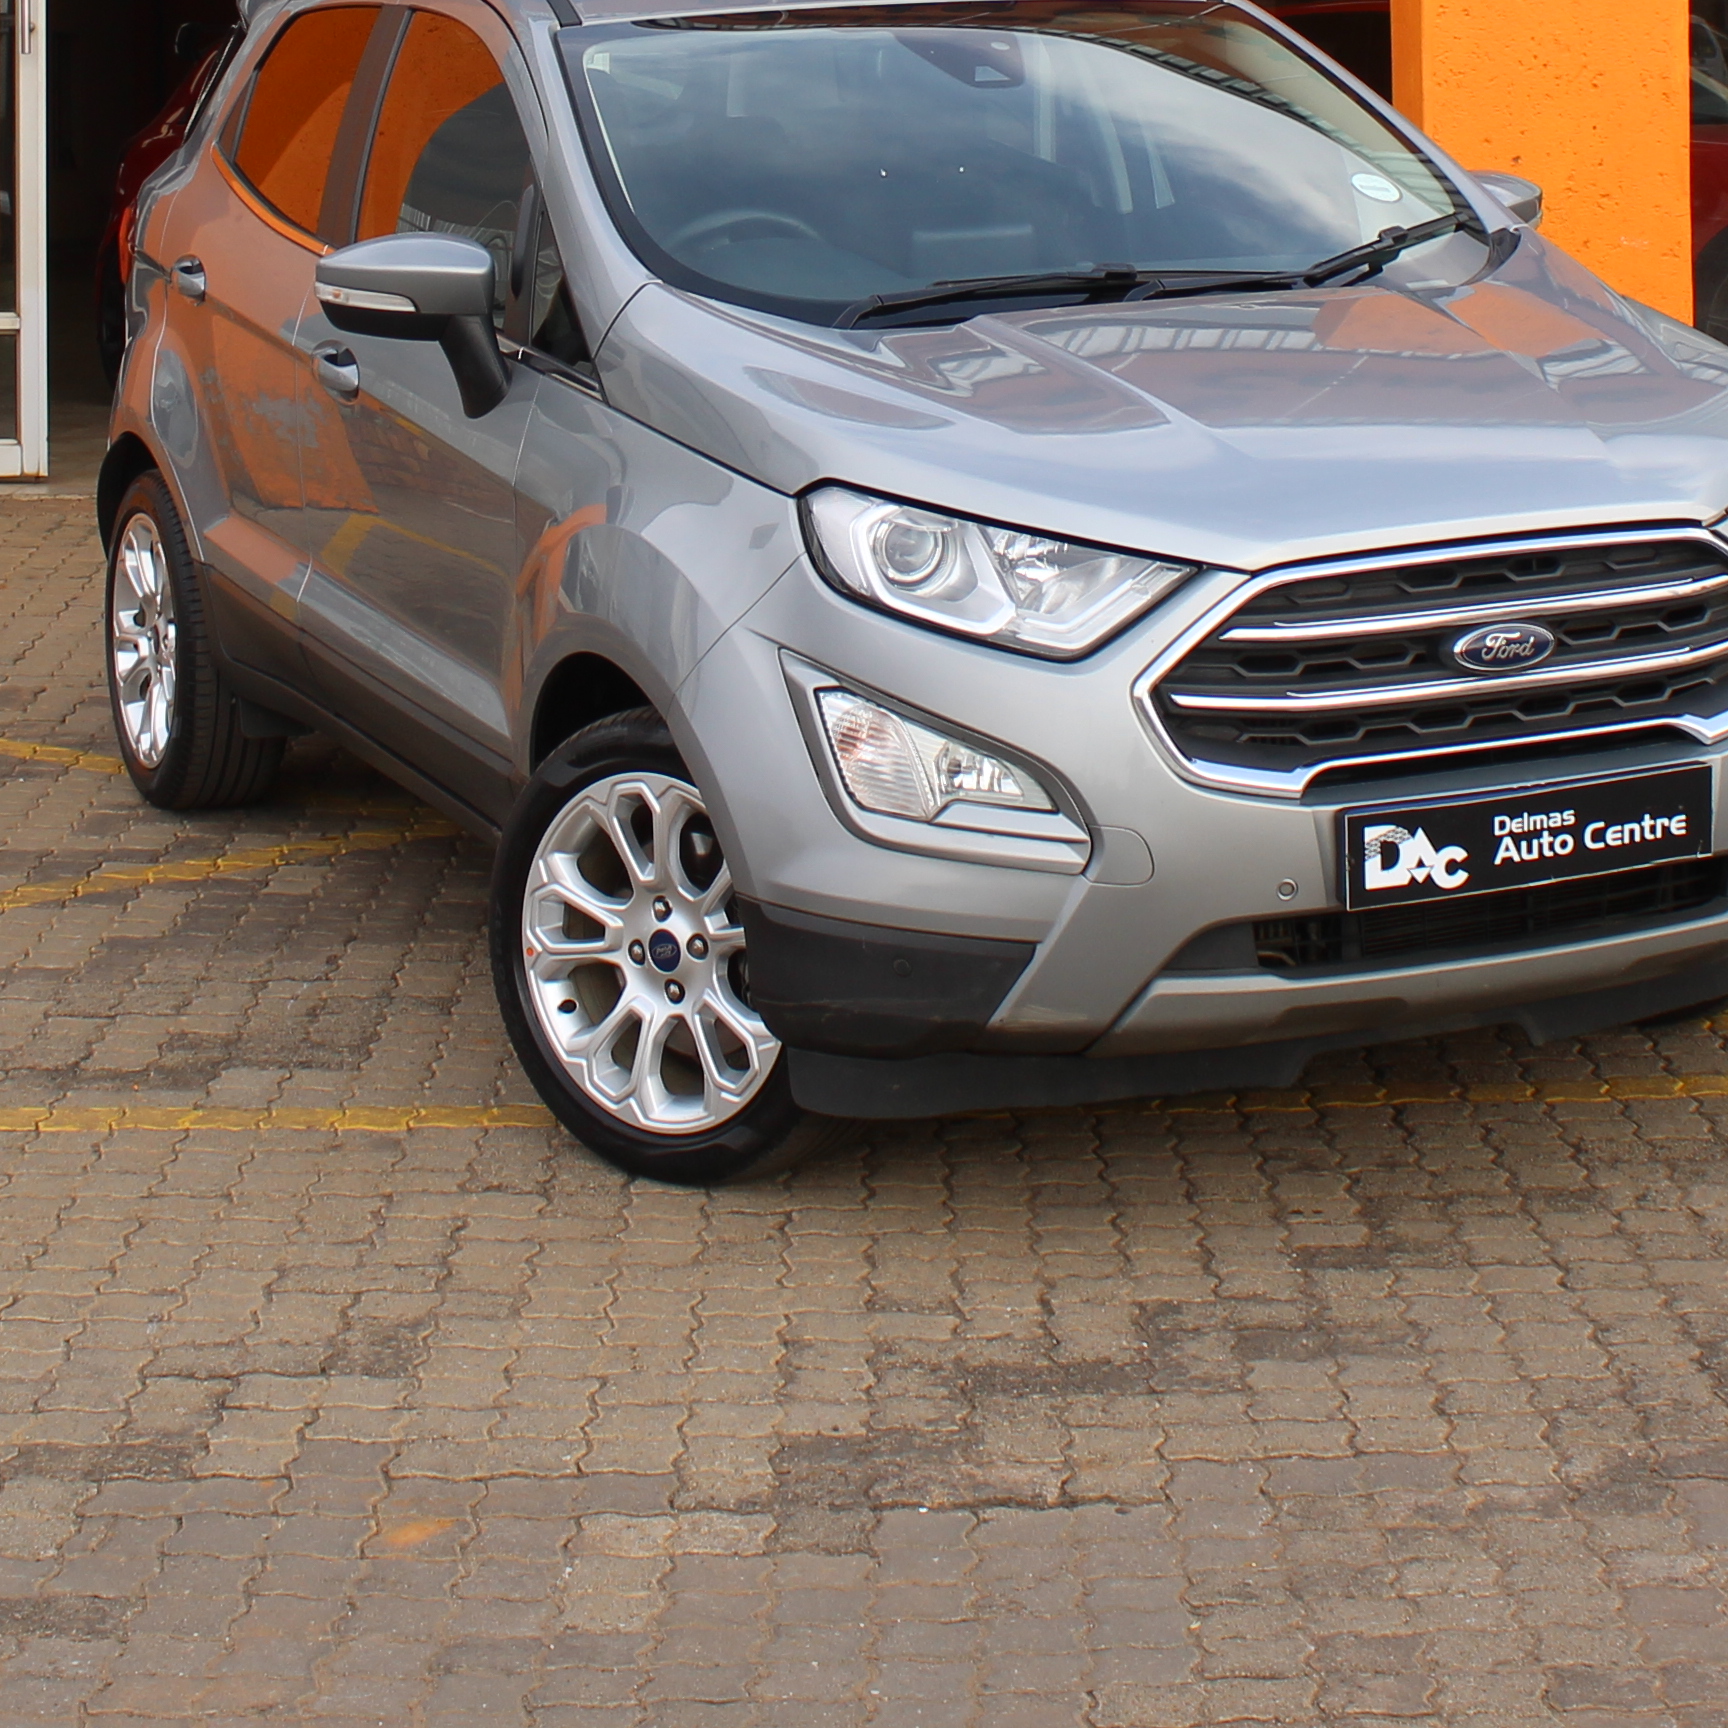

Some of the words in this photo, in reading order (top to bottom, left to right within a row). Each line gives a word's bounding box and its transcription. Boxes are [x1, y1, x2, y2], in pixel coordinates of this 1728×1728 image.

[1481, 630, 1535, 661] Ford
[1493, 810, 1576, 837] Delmas
[1493, 830, 1574, 866] Auto
[1584, 813, 1687, 850] Centre
[1364, 824, 1470, 890] DAC
